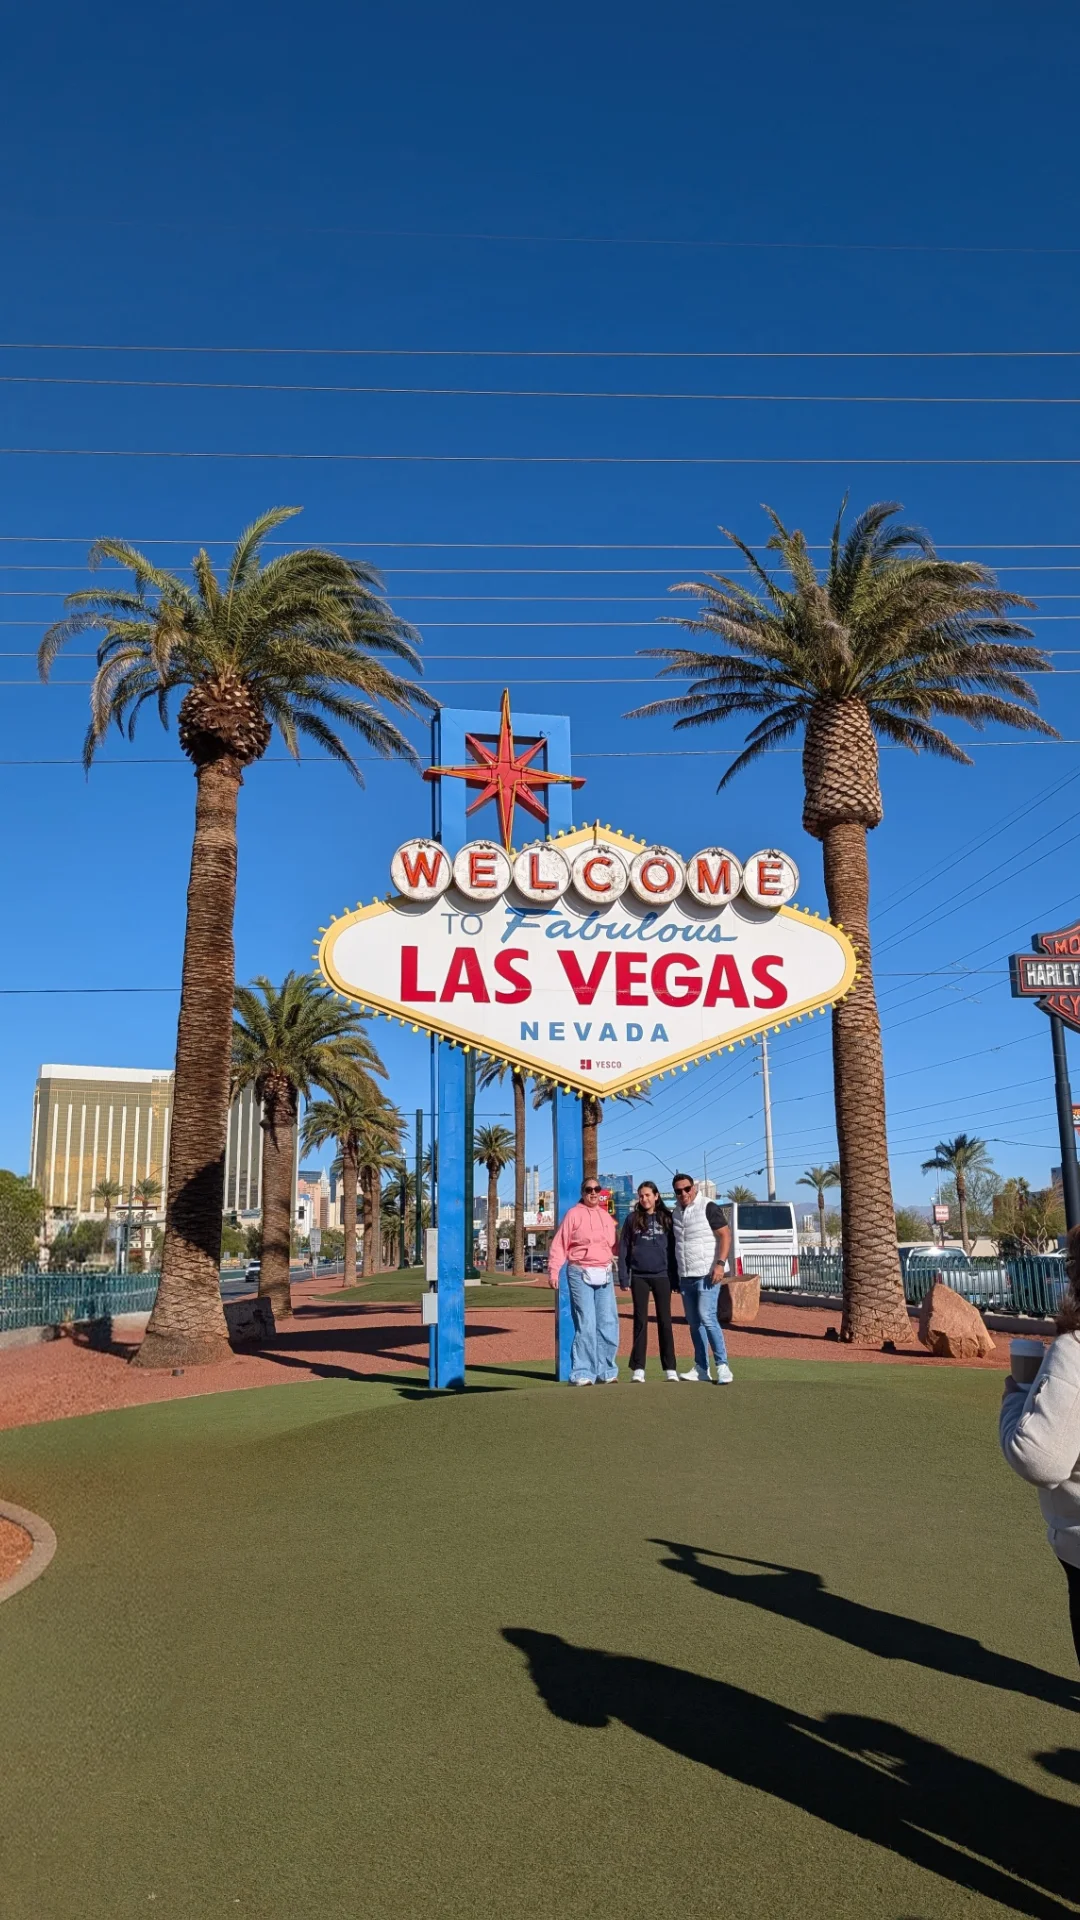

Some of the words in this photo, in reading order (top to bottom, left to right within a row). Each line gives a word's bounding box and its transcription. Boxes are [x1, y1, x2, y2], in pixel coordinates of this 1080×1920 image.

[400, 850, 782, 896] WELCOME
[440, 913, 484, 936] TO
[500, 907, 738, 944] Fabulous
[400, 945, 533, 1005] LAS
[556, 950, 788, 1010] VEGAS
[520, 1021, 670, 1043] NEVADA
[595, 1060, 622, 1070] YESCO
